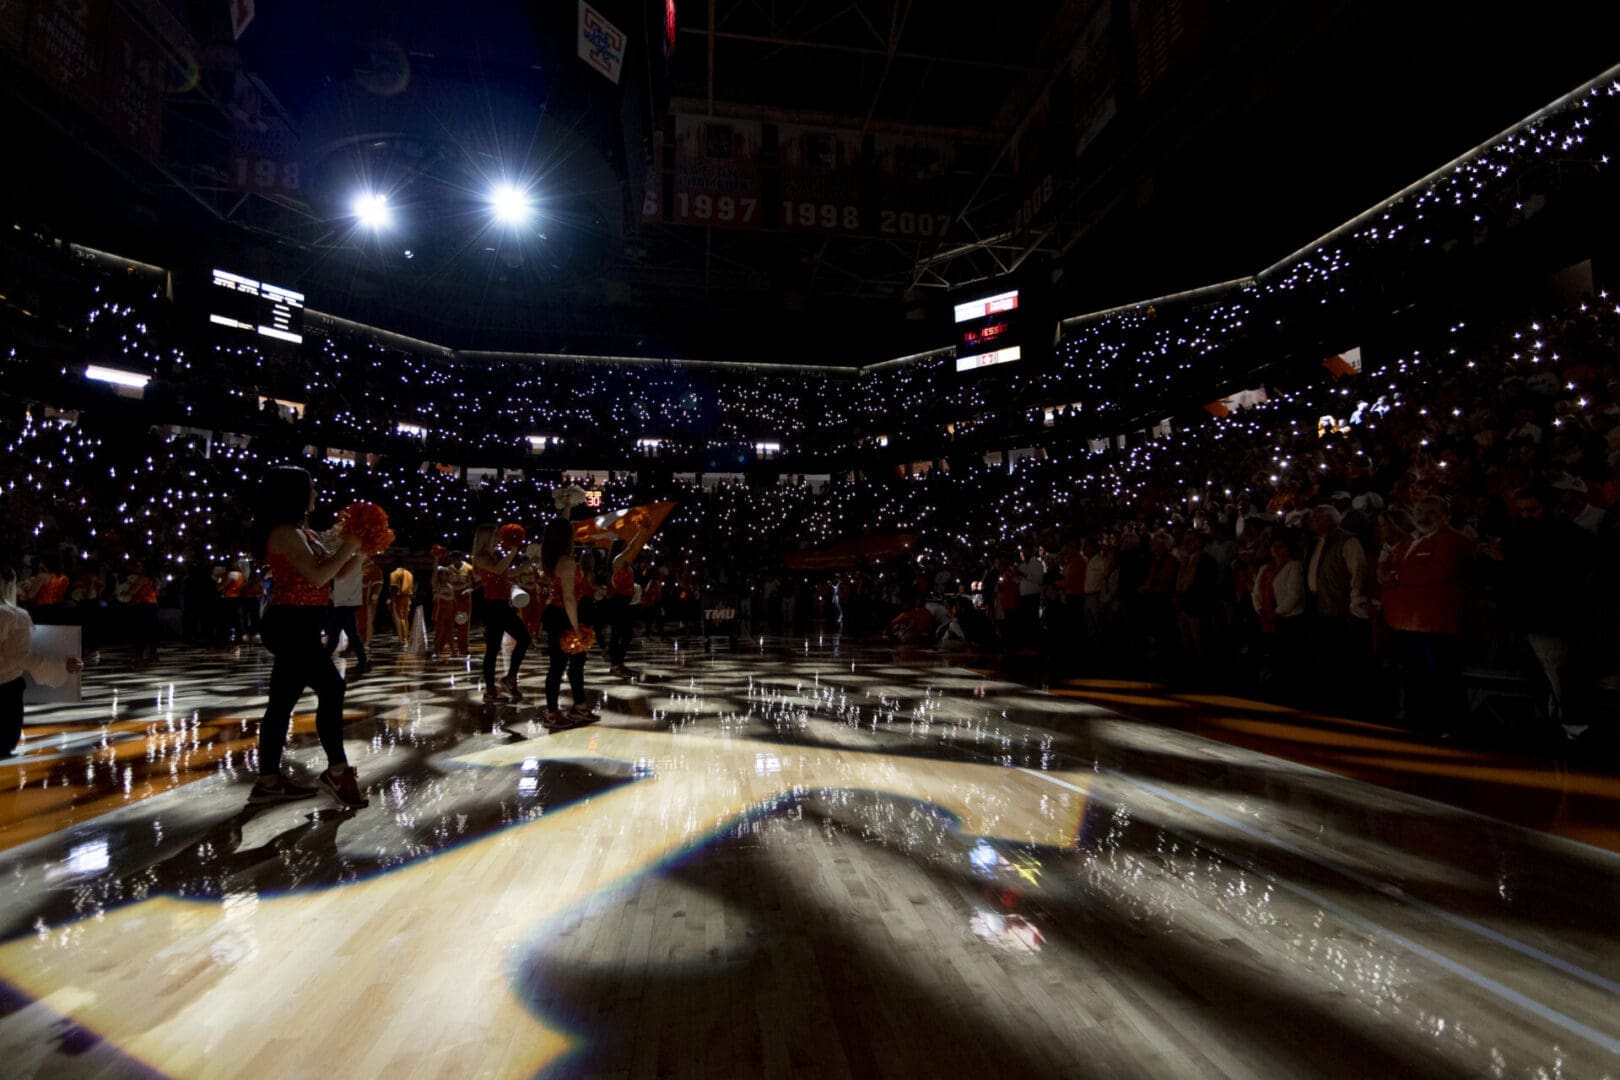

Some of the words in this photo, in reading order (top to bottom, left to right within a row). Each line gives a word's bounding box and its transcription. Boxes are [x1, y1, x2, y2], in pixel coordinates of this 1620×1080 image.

[677, 191, 758, 224] 1997
[782, 200, 861, 231] 1998
[879, 209, 953, 239] 2007
